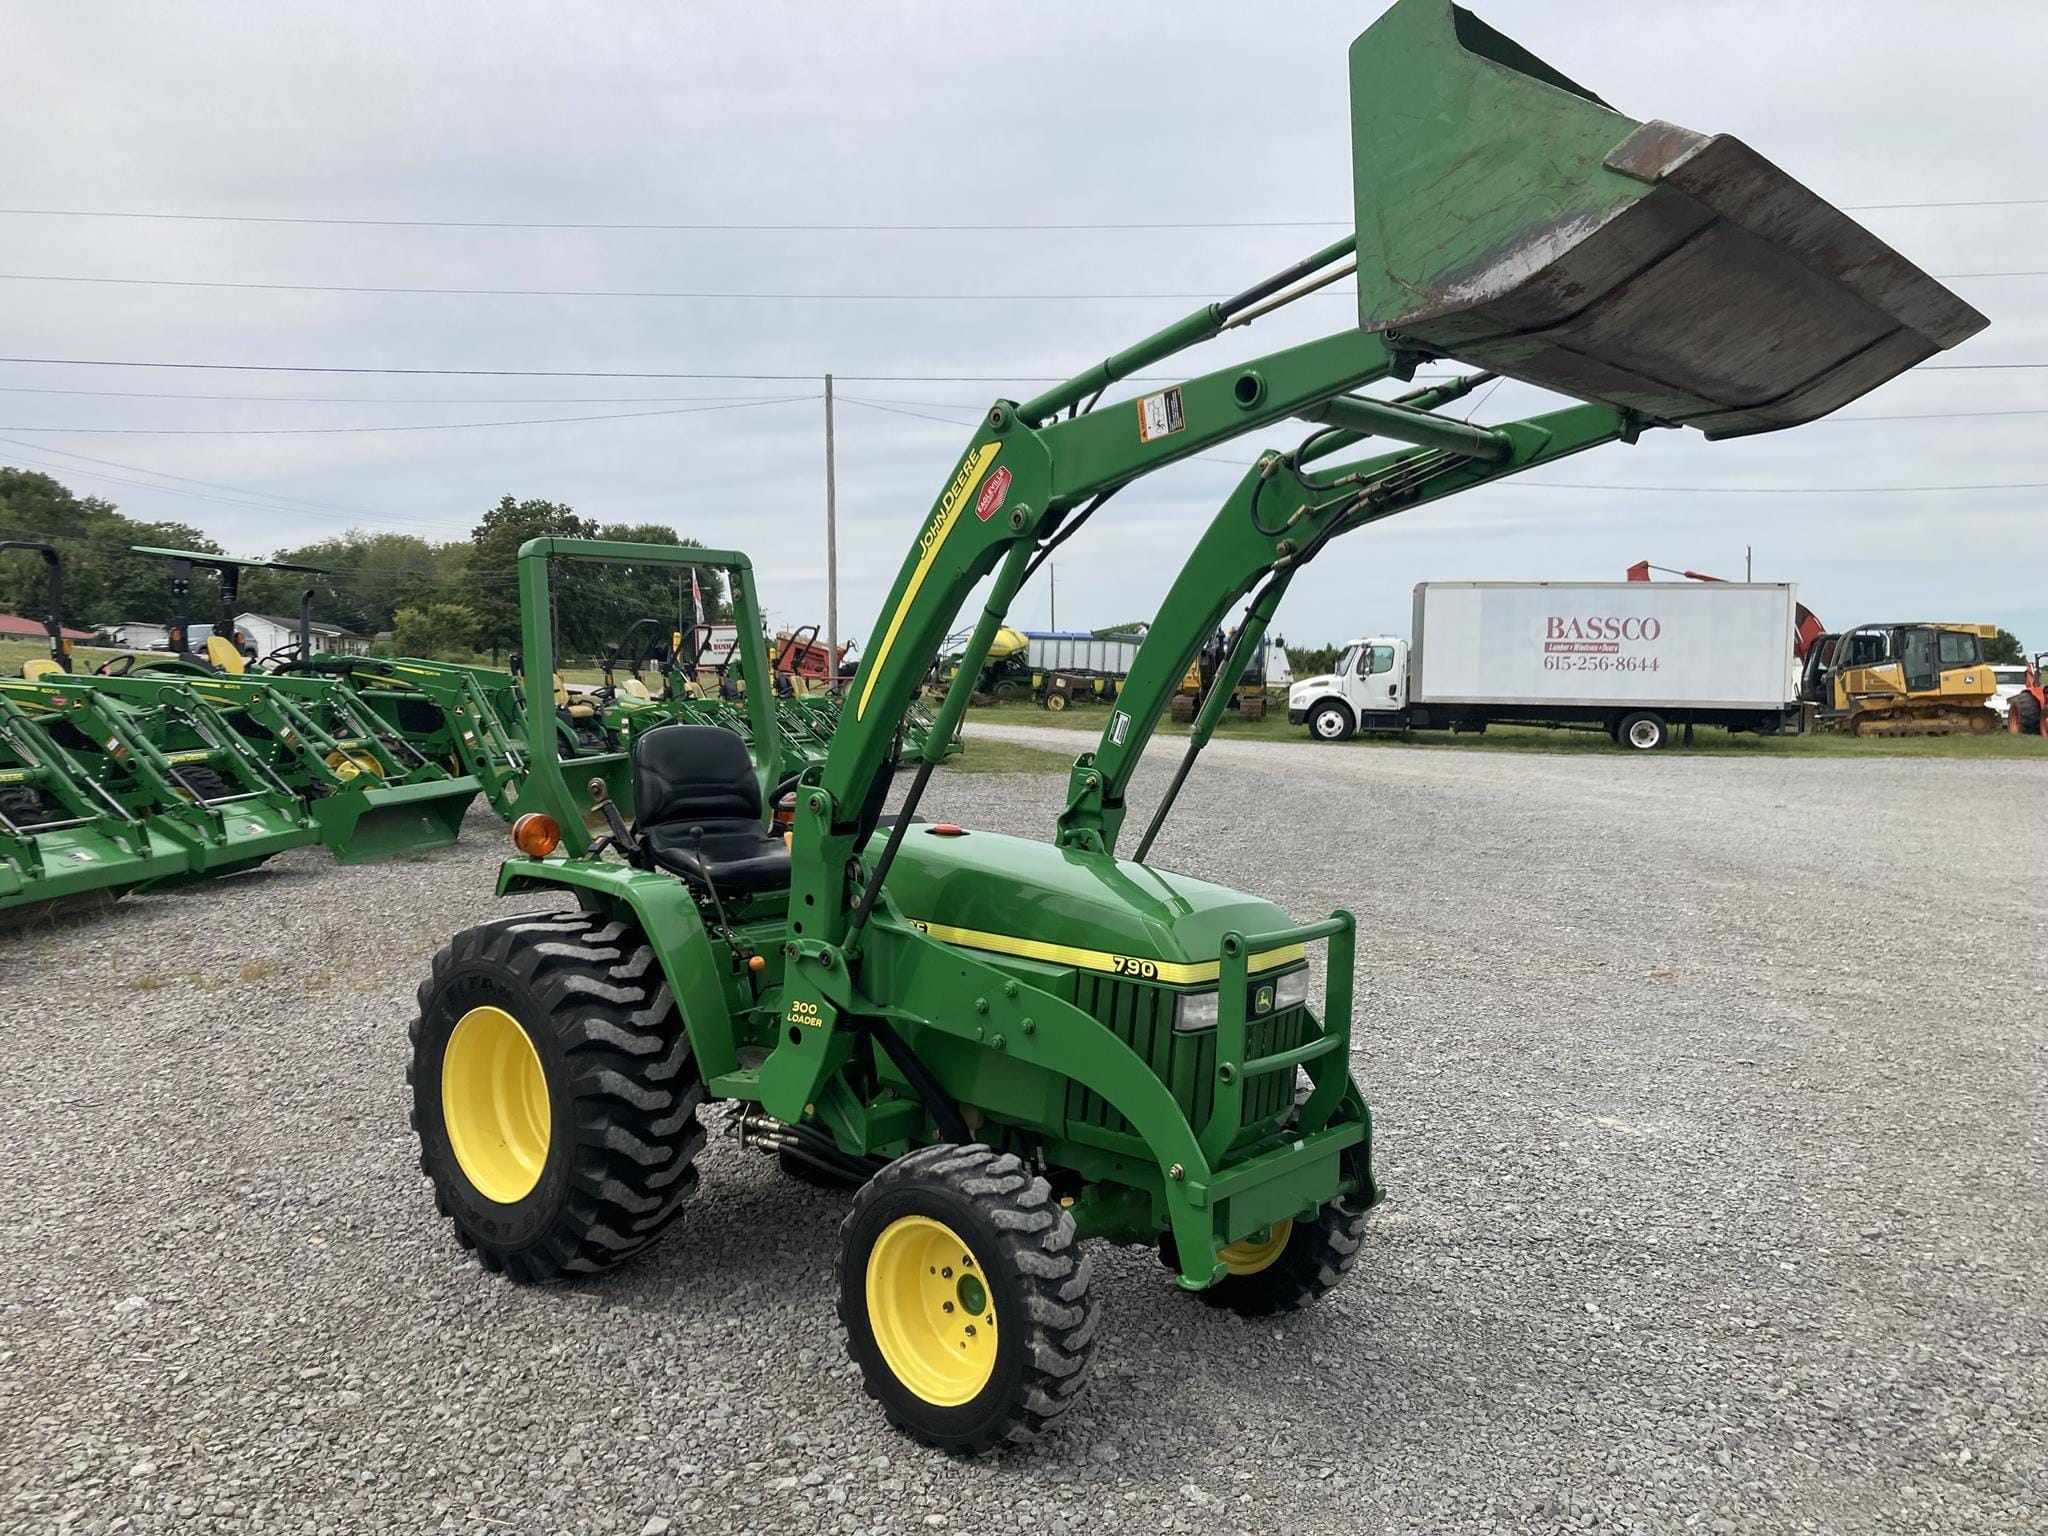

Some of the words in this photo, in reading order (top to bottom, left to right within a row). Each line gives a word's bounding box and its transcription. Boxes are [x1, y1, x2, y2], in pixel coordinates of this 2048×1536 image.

[977, 469, 1005, 513] EAGLEVILLE
[919, 508, 949, 559] JOHN
[942, 448, 981, 513] DEERE
[1546, 616, 1661, 641] BASSCO
[1548, 642, 1570, 652] Lumber
[1543, 655, 1660, 672] 615-256-8644
[1113, 956, 1158, 979] 790
[791, 1000, 818, 1015] 300
[786, 1012, 823, 1028] LOADER
